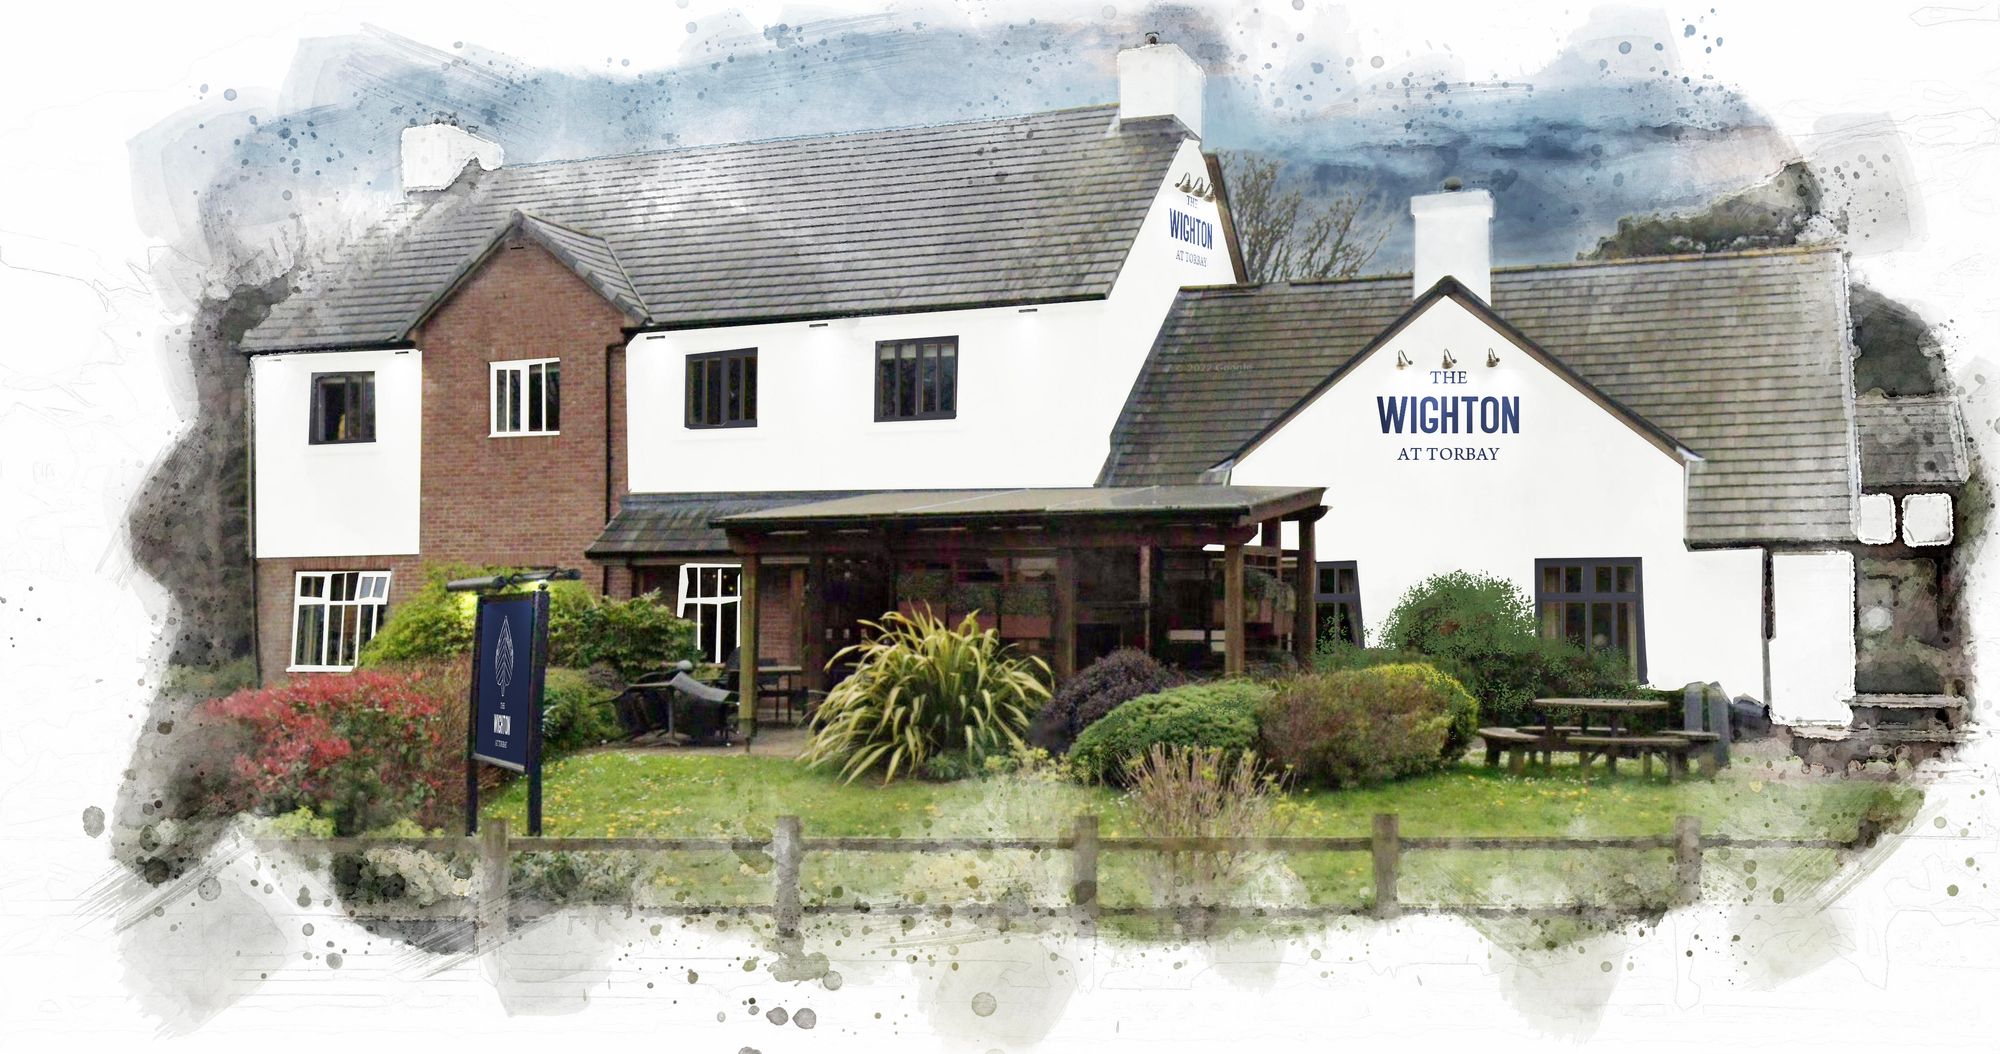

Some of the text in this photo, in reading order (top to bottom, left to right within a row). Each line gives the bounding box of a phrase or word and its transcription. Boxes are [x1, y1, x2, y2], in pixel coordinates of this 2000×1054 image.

[1169, 207, 1213, 250] WIGHTON
[1175, 250, 1184, 261] AT
[1429, 370, 1468, 384] THE
[1376, 396, 1520, 434] WIGHTON
[1397, 447, 1500, 461] AT TORBAY
